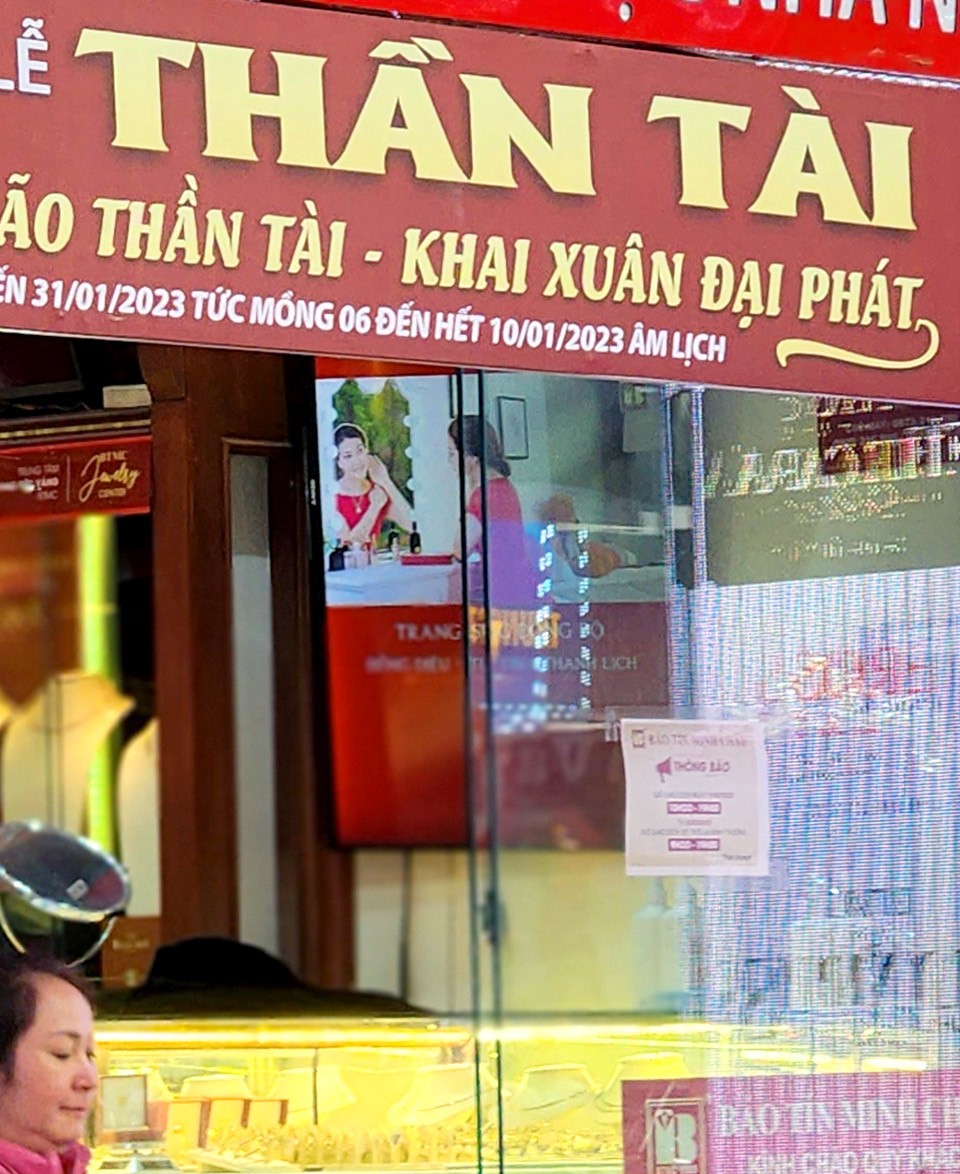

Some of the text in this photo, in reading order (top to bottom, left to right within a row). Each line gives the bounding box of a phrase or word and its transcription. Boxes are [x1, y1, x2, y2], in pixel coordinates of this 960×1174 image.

[74, 27, 597, 196] THẦN
[646, 85, 917, 230] TÀI
[31, 279, 186, 318] 31/01/2023
[191, 286, 245, 322] TỨC
[249, 288, 334, 332] MỒNG
[340, 304, 371, 333] 06
[376, 300, 431, 339] ĐẾN
[433, 305, 486, 344] HẾT
[490, 317, 624, 354] 10/01/2023
[628, 321, 668, 358] ÂM
[672, 333, 727, 369] LỊCH
[92, 174, 242, 269] THẦN
[260, 200, 347, 278] TÀI
[400, 229, 530, 294] KHAI
[543, 232, 685, 307] XUÂN
[700, 258, 783, 330] ĐẠI
[798, 258, 924, 330] PHÁT
